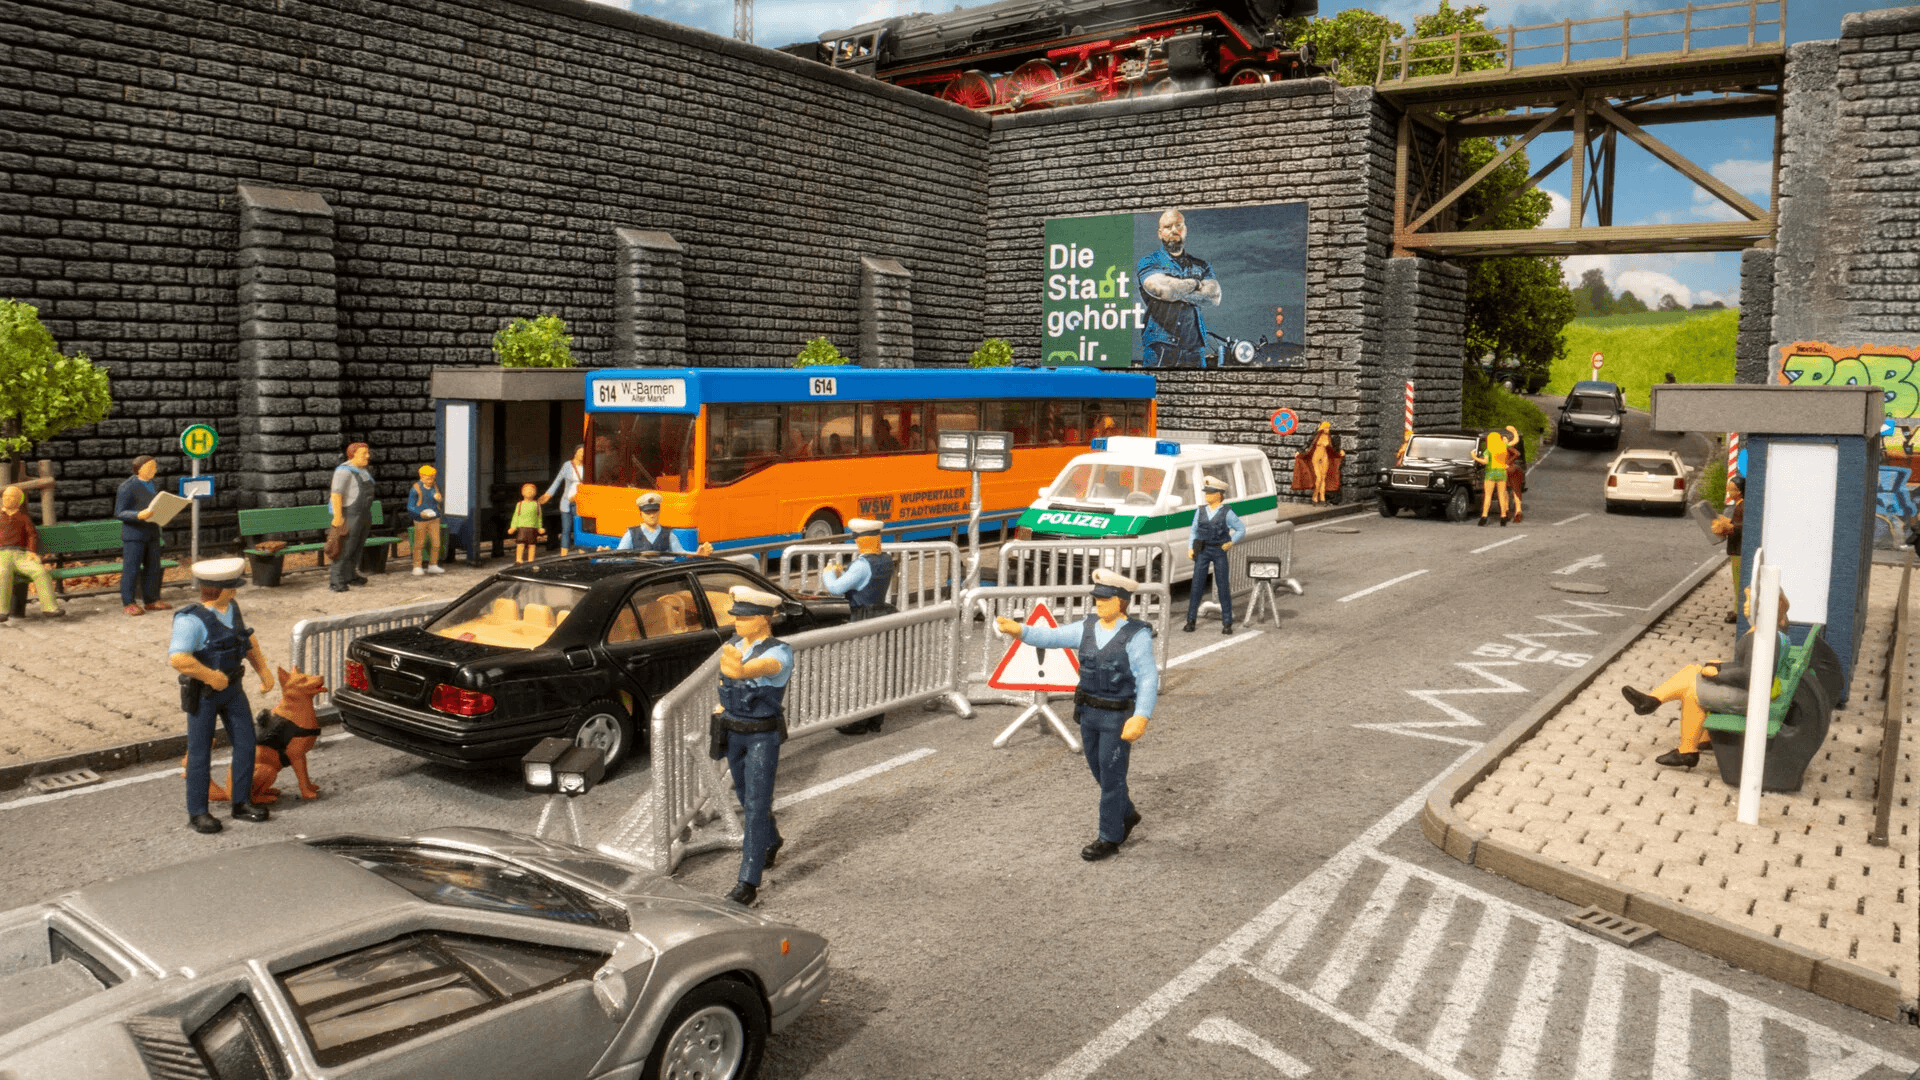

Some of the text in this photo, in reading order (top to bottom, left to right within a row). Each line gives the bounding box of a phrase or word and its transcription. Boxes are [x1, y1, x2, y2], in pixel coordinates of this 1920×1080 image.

[1049, 243, 1094, 269] Die
[1047, 303, 1145, 337] gehört
[600, 382, 674, 402] 614 W.-Barmen
[814, 379, 832, 393] 614
[191, 432, 207, 450] H
[900, 487, 965, 503] WUPPERTALER
[860, 499, 891, 513] WSW
[900, 502, 959, 518] STADTWERKE
[1037, 513, 1110, 529] POLIZEI
